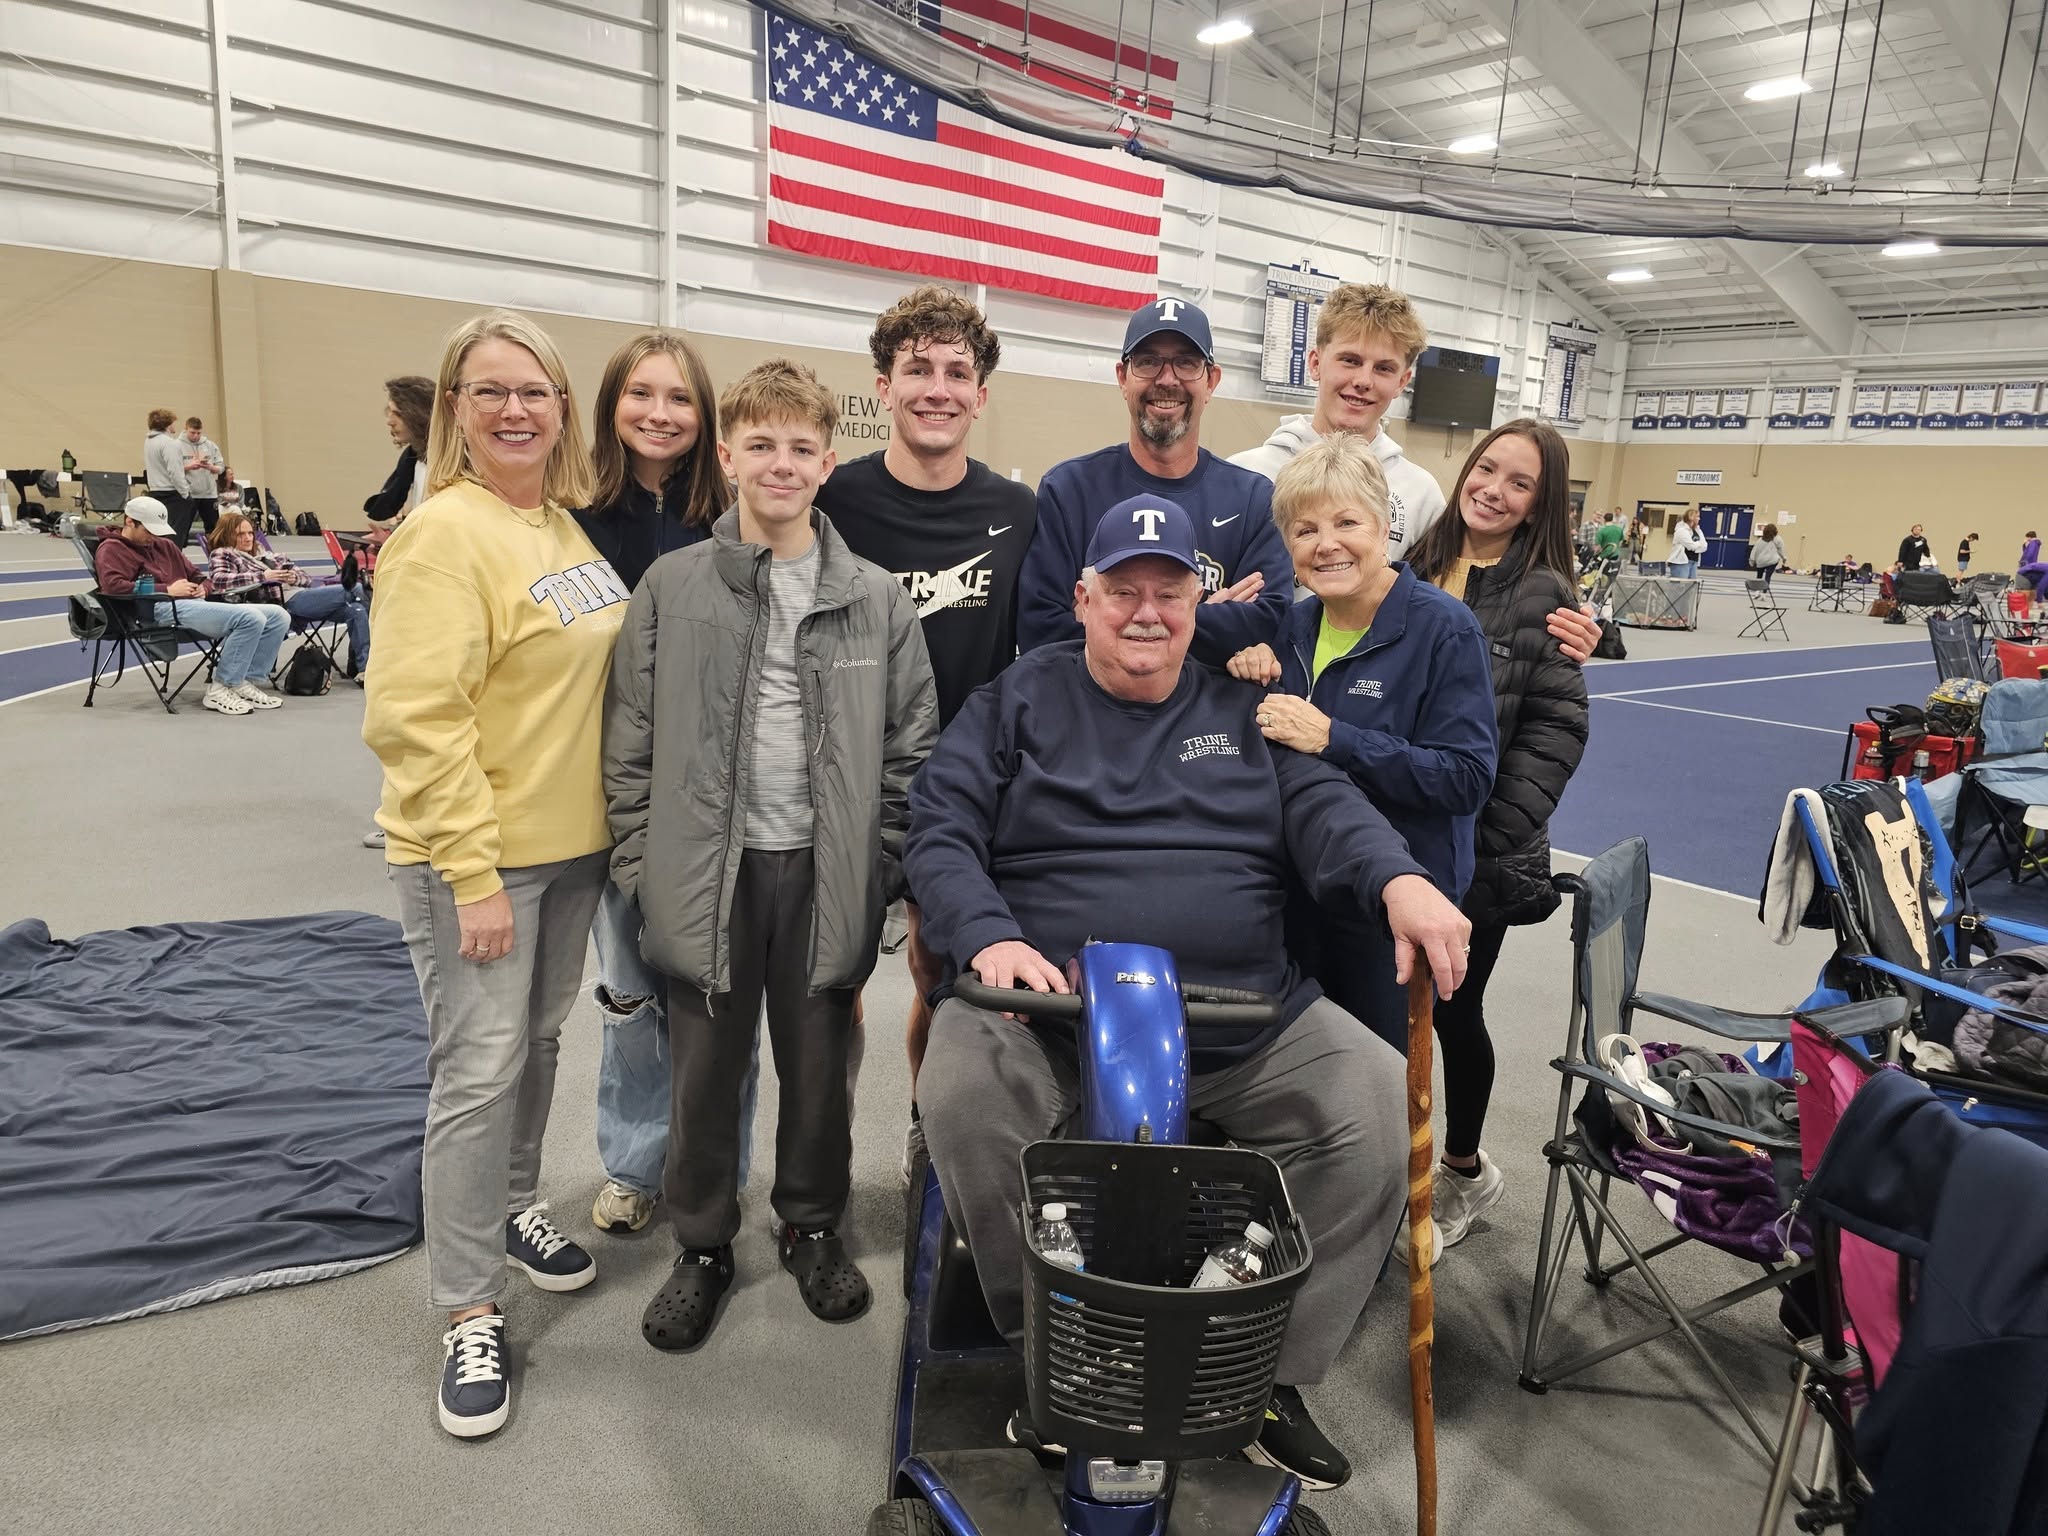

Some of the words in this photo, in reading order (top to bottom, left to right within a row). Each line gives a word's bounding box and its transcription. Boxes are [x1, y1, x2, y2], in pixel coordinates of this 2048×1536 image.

[1303, 260, 1310, 272] T
[1155, 299, 1185, 322] T
[837, 394, 881, 418] IEW
[835, 421, 891, 441] MEDICI
[1684, 473, 1720, 482] RESTROOMS
[1391, 492, 1405, 510] IGHT
[1132, 509, 1166, 541] T
[529, 559, 631, 627] TRIN
[840, 657, 878, 668] Columbia
[1347, 687, 1384, 699] WRESTLING
[1354, 679, 1382, 691] TRINE
[1183, 733, 1230, 750] TRINE
[1179, 746, 1240, 763] WRESTLING
[1116, 972, 1156, 985] Pride
